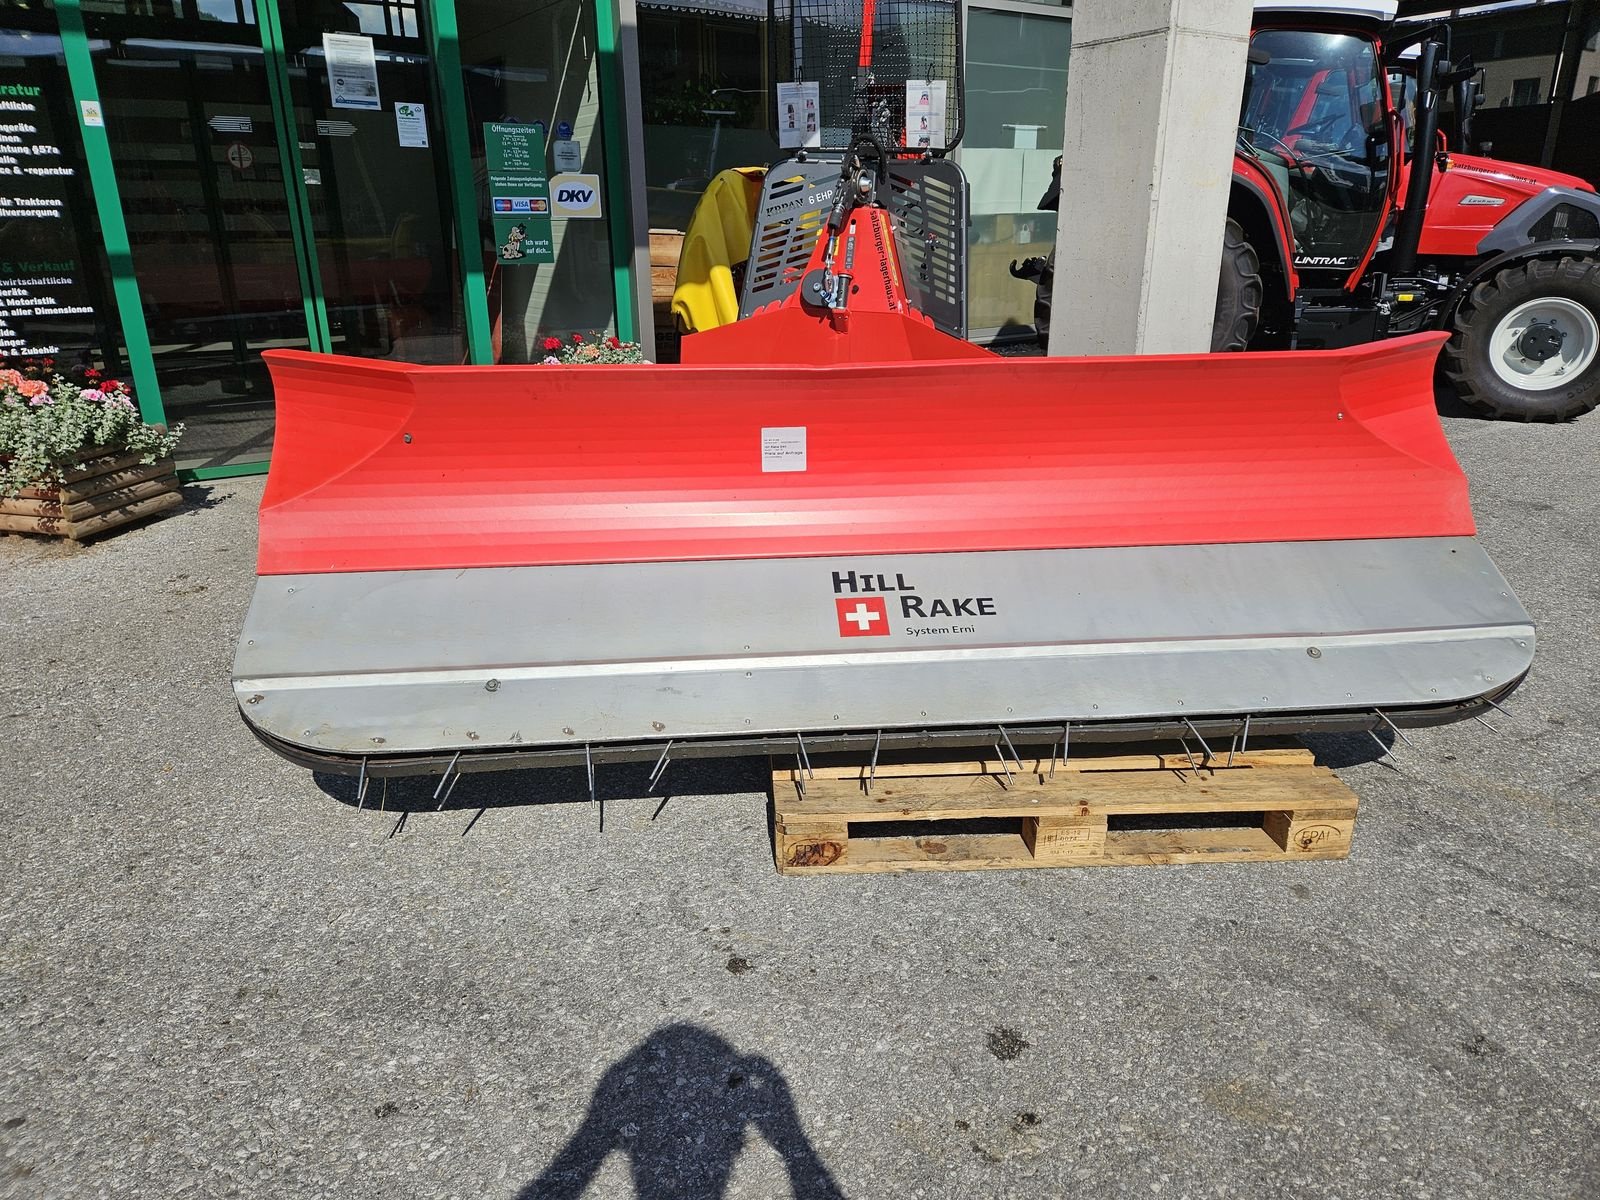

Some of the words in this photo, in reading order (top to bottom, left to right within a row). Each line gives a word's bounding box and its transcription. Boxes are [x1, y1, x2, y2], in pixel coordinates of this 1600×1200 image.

[0, 84, 41, 96] ratur
[491, 124, 536, 134] Öffnungszeiten
[0, 145, 31, 155] htung
[32, 145, 61, 155] §57a
[13, 166, 23, 175] &
[24, 167, 75, 177] -reparatur
[557, 190, 593, 202] DKV
[808, 195, 815, 204] 6
[815, 189, 833, 203] EHP
[14, 198, 63, 207] Traktoren
[514, 200, 529, 208] VISA
[870, 210, 896, 310] salzburger-lagerhaus.at
[1294, 256, 1347, 264] LINTRAC
[2, 263, 13, 272] &
[18, 260, 75, 272] Verkauf
[6, 297, 56, 306] Motoristik
[11, 307, 33, 316] aller
[34, 305, 94, 315] Dimensionen
[21, 345, 59, 355] Zubehör
[906, 626, 949, 637] System
[952, 625, 975, 633] Erni
